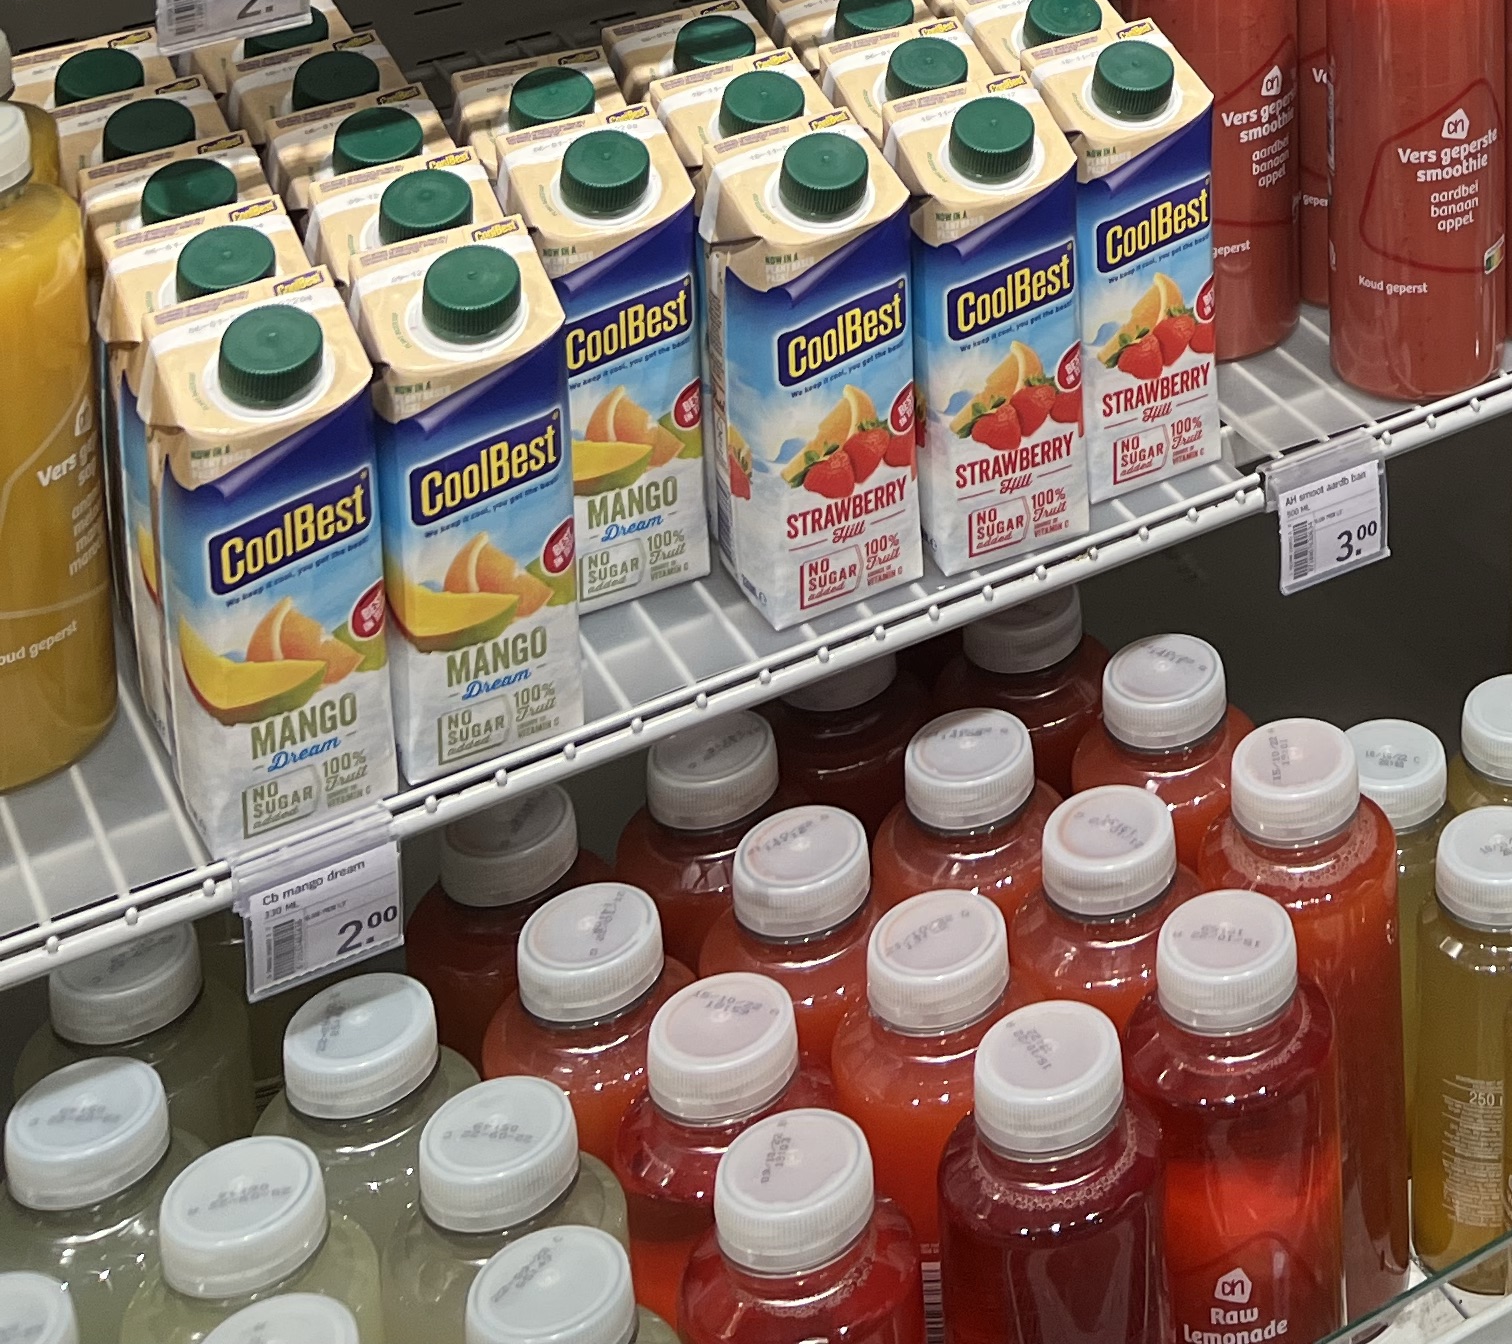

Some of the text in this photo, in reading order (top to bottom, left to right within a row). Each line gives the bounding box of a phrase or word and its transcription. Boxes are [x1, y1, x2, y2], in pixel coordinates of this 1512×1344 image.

[1397, 127, 1498, 165] Vers geperste
[1416, 153, 1488, 183] smoothie
[1430, 179, 1479, 205] aardbei
[1430, 196, 1479, 218] banaan
[1105, 189, 1209, 266] CoolBest
[1437, 212, 1474, 233] appel
[956, 254, 1071, 333] CoolBest
[1358, 275, 1428, 296] Koud geperst
[565, 290, 690, 371] CoolBest
[787, 293, 903, 379] CoolBest
[1102, 362, 1210, 418] STRAWBERRY
[1142, 402, 1173, 424] Hill
[420, 424, 557, 518] CoolBest
[955, 431, 1074, 489] STRAWBERRY
[1000, 475, 1032, 494] Hill
[1285, 495, 1296, 506] AH
[1326, 476, 1349, 492] aardb
[1351, 472, 1366, 482] ban
[587, 475, 679, 530] MANGO
[785, 474, 907, 540] STRAWBERRY
[220, 486, 367, 587] CoolBest
[601, 514, 664, 542] Dream
[832, 520, 866, 545] Hill
[1336, 520, 1378, 562] 3.00
[864, 534, 899, 557] 100%
[866, 547, 901, 571] Fruit
[808, 559, 830, 575] NO
[808, 564, 858, 591] SUGAR
[807, 580, 846, 601] added
[445, 627, 549, 689] MANGO
[461, 668, 533, 701] Dream
[250, 692, 359, 761] MANGO
[262, 861, 365, 906] Cb mango dream
[336, 905, 398, 955] 2.00
[1183, 1319, 1288, 1344] Lemonade
[1210, 1307, 1259, 1325] Raw
